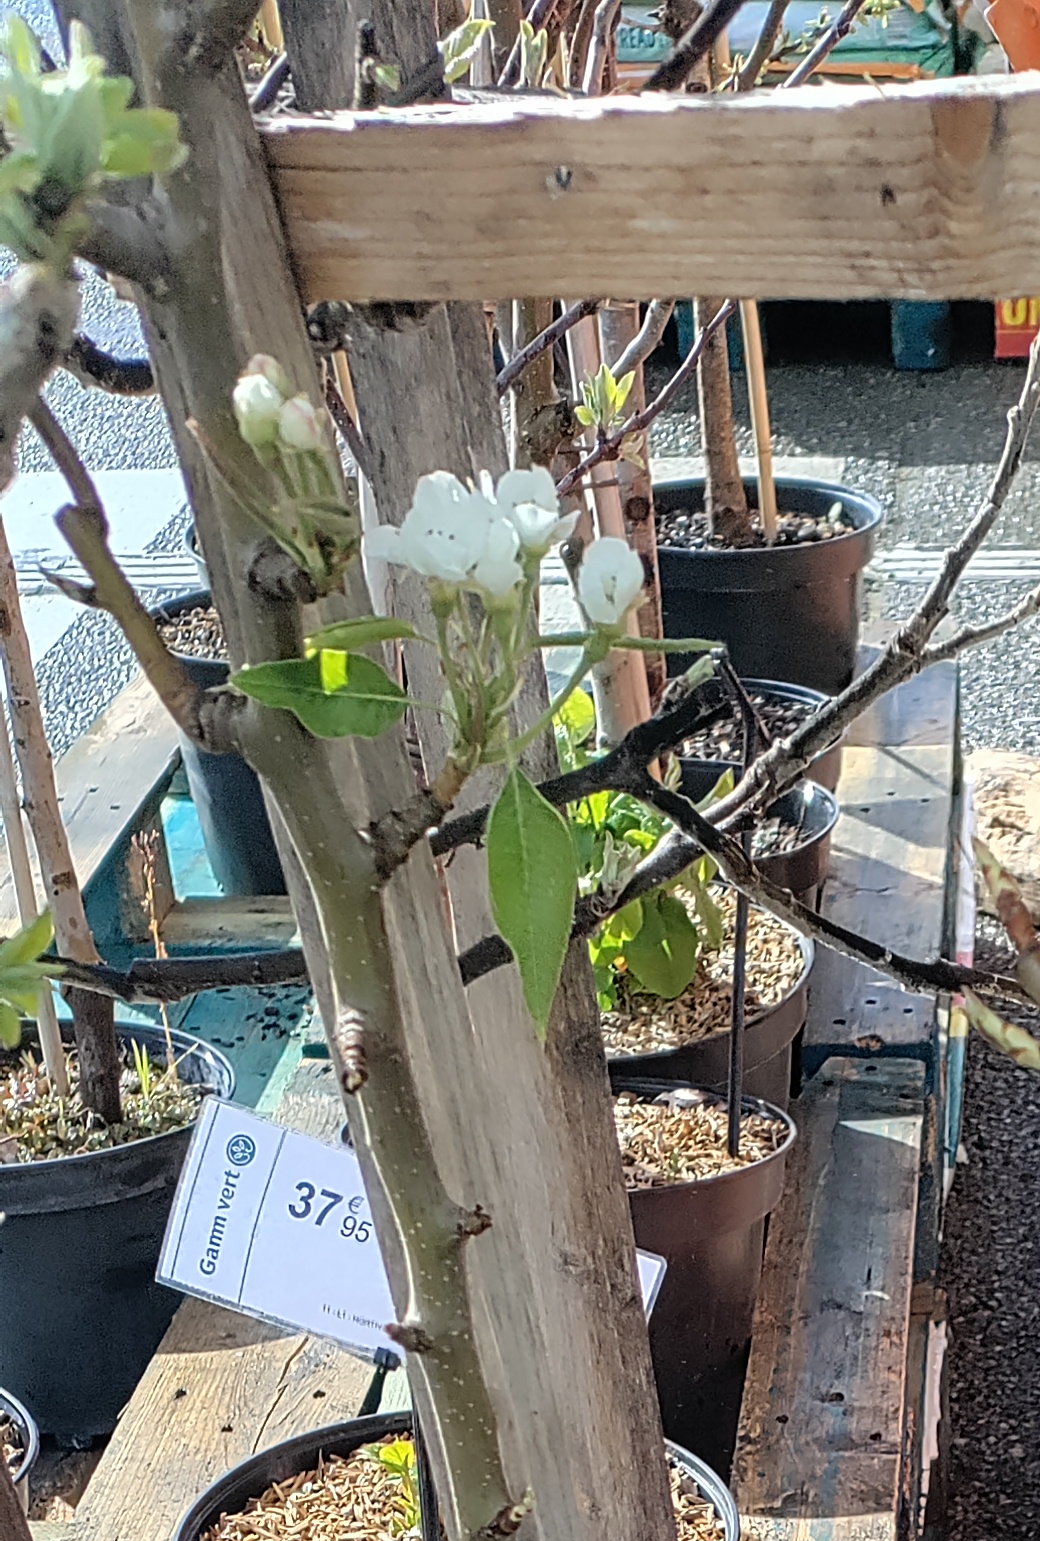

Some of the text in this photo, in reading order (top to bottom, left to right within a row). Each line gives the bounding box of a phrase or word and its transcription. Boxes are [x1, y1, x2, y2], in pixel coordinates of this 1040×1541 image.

[199, 1169, 241, 1276] Gamm vert
[288, 1181, 343, 1228] 37
[340, 1214, 373, 1244] 95
